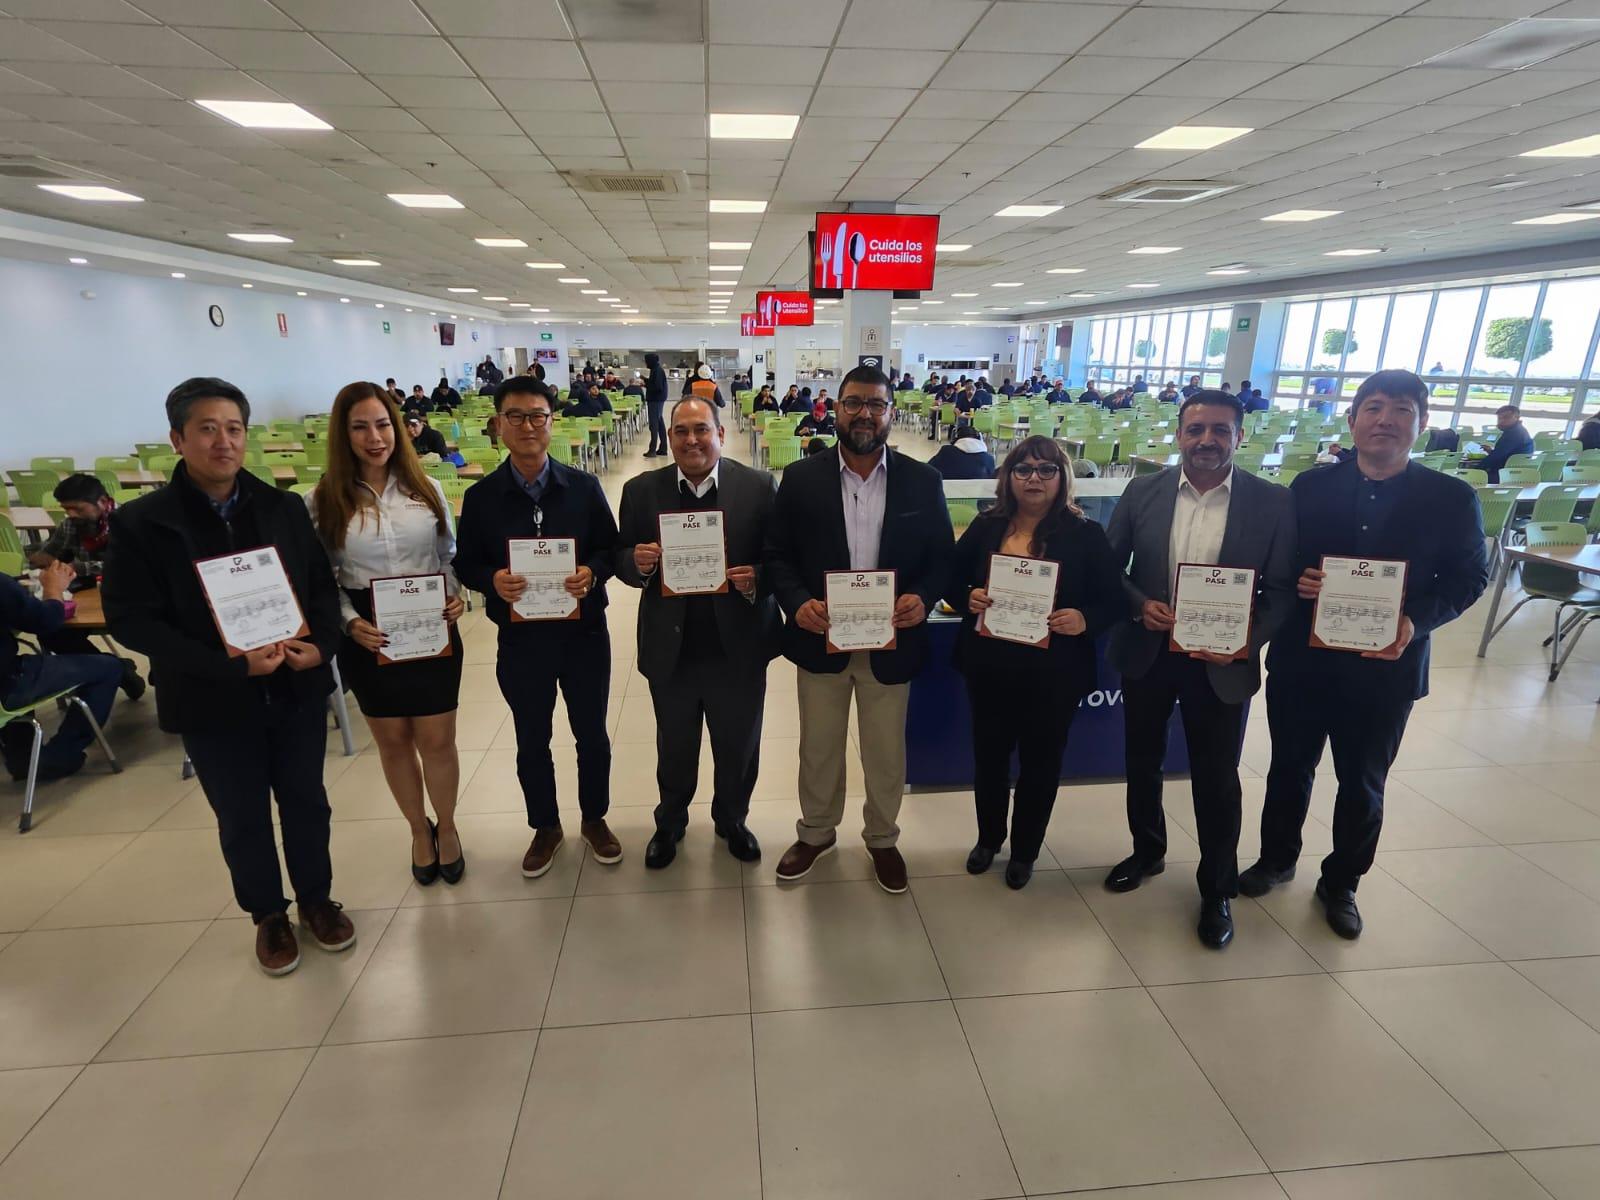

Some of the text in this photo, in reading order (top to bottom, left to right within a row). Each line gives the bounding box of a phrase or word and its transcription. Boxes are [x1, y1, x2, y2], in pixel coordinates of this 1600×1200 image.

[869, 239, 923, 251] Cuida los
[868, 251, 923, 263] utensilios
[230, 564, 252, 574] PASE
[1014, 567, 1033, 575] PASE
[1351, 569, 1375, 577] PASE
[1205, 577, 1227, 585] PASE
